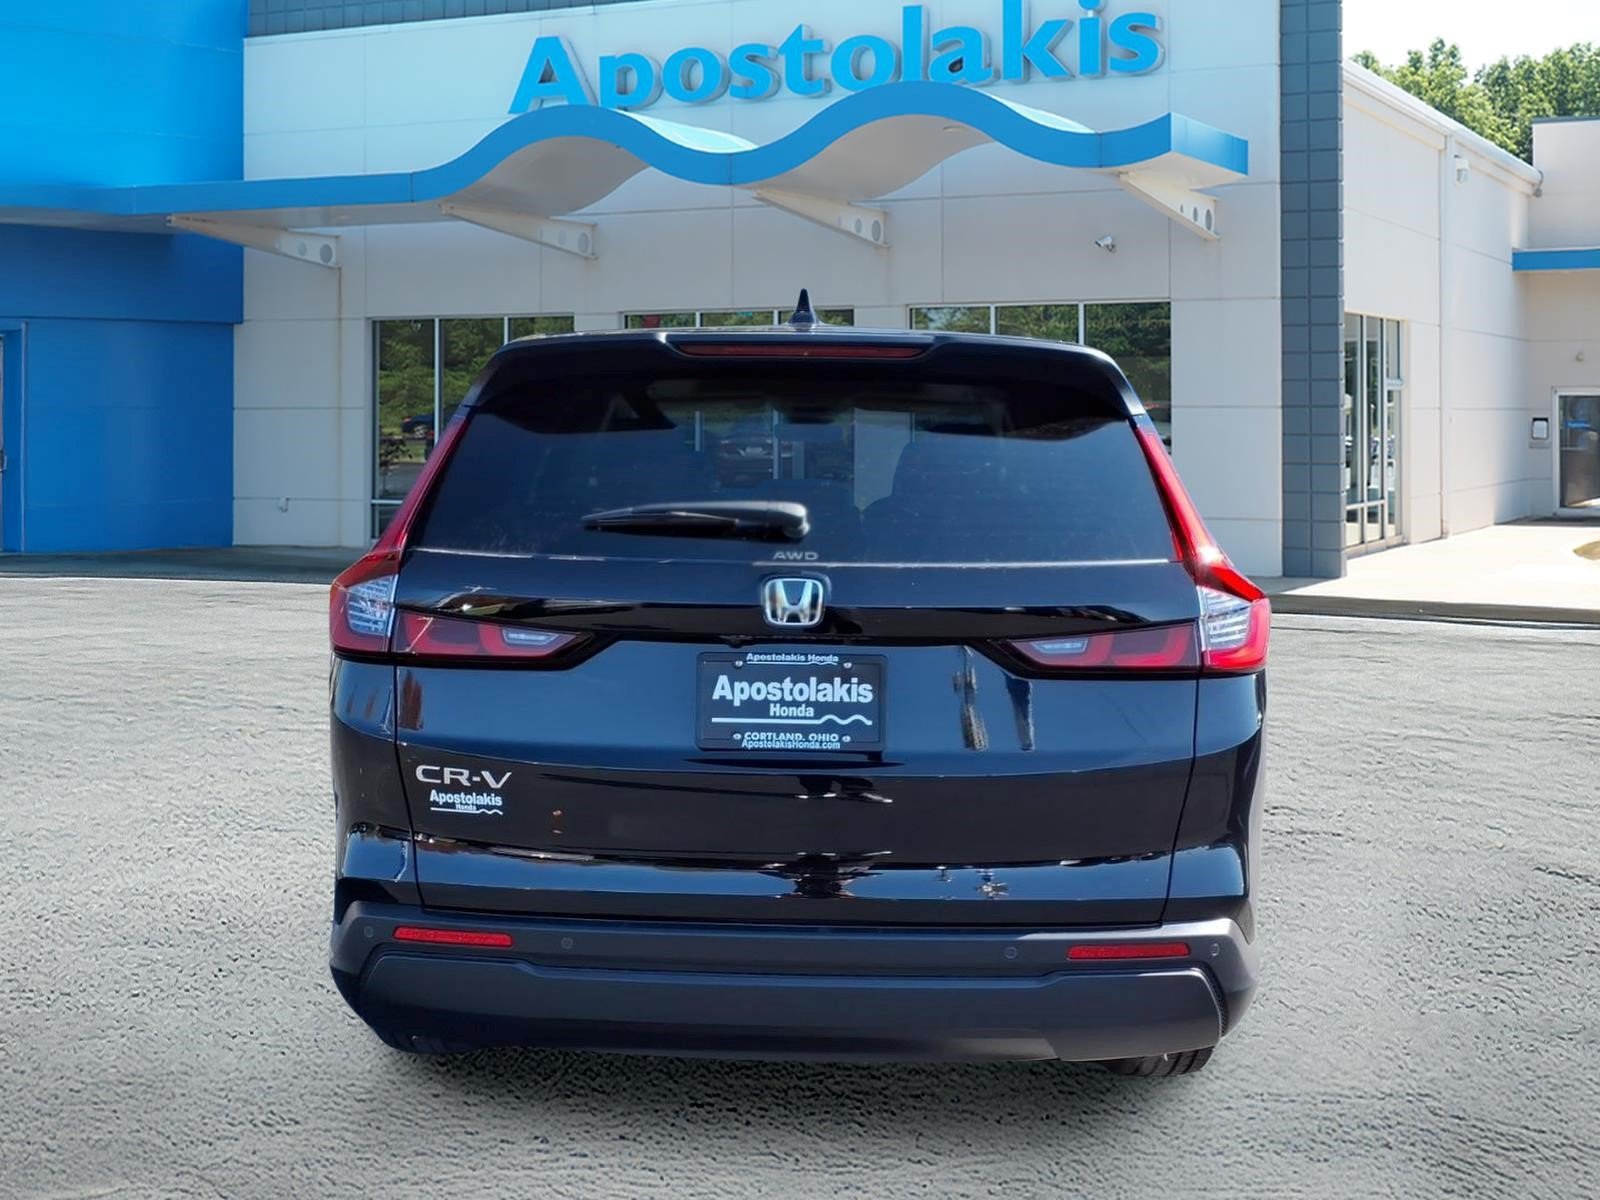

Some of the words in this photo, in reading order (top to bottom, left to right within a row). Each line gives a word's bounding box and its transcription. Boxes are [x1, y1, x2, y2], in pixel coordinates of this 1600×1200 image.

[508, 0, 1164, 114] Apostolakis
[772, 551, 819, 560] AWD
[746, 653, 806, 662] Apostolakis
[807, 654, 839, 662] Honda
[712, 675, 873, 706] Apostolakis
[769, 703, 815, 717] Honda
[741, 739, 841, 750] ApostolakisHonda.com
[808, 733, 839, 742] OHIO
[415, 764, 512, 789] CR-V
[430, 789, 502, 806] Apostolakis
